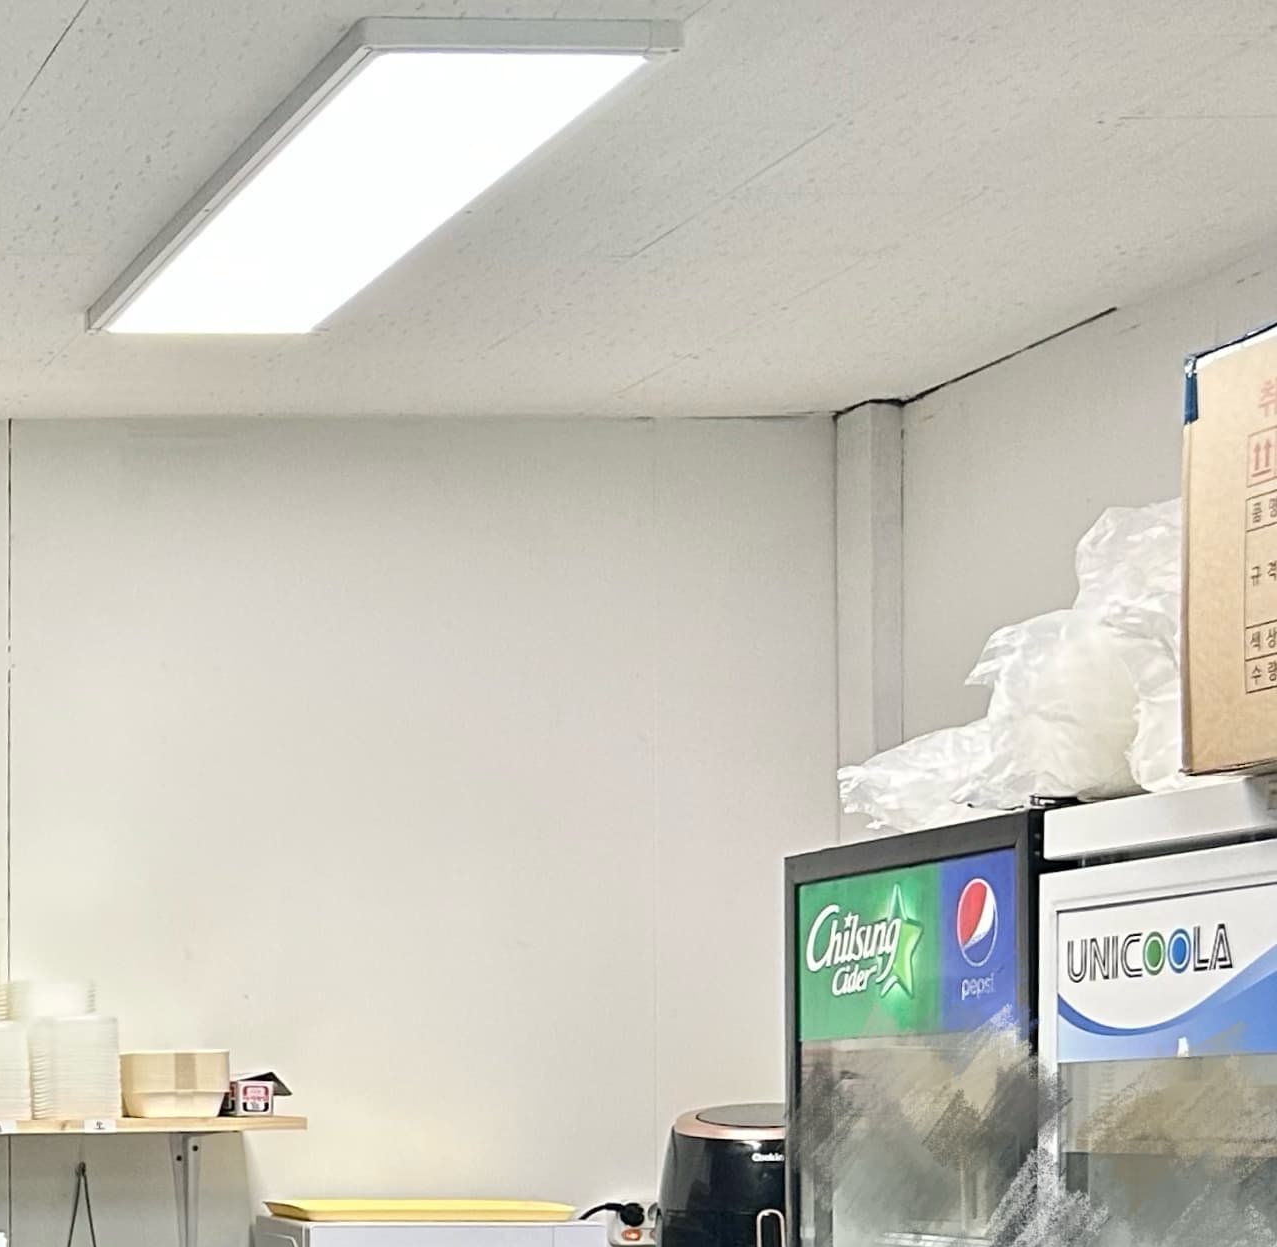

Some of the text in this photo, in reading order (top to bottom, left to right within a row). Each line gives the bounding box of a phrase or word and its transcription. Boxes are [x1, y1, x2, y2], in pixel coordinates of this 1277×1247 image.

[806, 904, 902, 984] Chilsung
[1067, 923, 1233, 984] UNICOOLA
[832, 961, 879, 997] Cider
[960, 970, 996, 1000] pepsi
